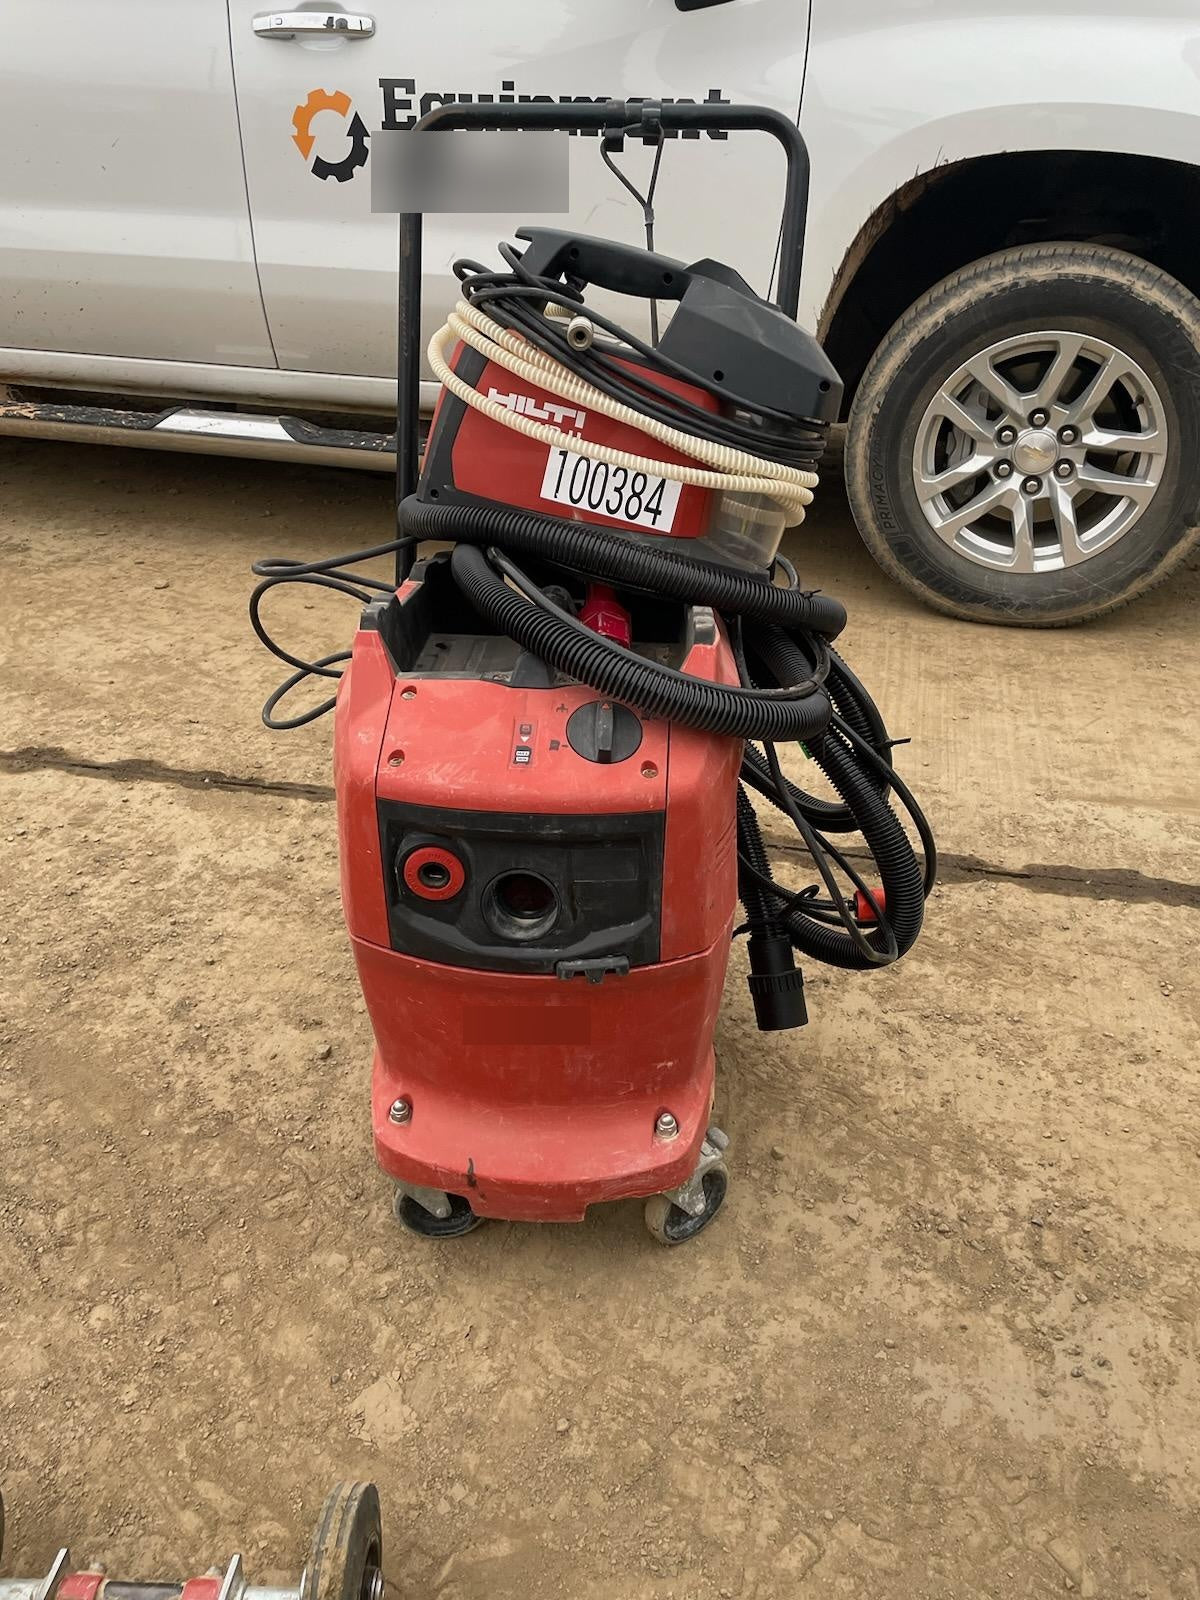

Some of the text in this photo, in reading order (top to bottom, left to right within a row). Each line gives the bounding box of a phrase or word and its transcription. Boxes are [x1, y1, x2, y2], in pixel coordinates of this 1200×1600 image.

[487, 387, 586, 429] HILTI
[553, 450, 667, 526] 100384
[872, 457, 896, 530] PRIMACY
